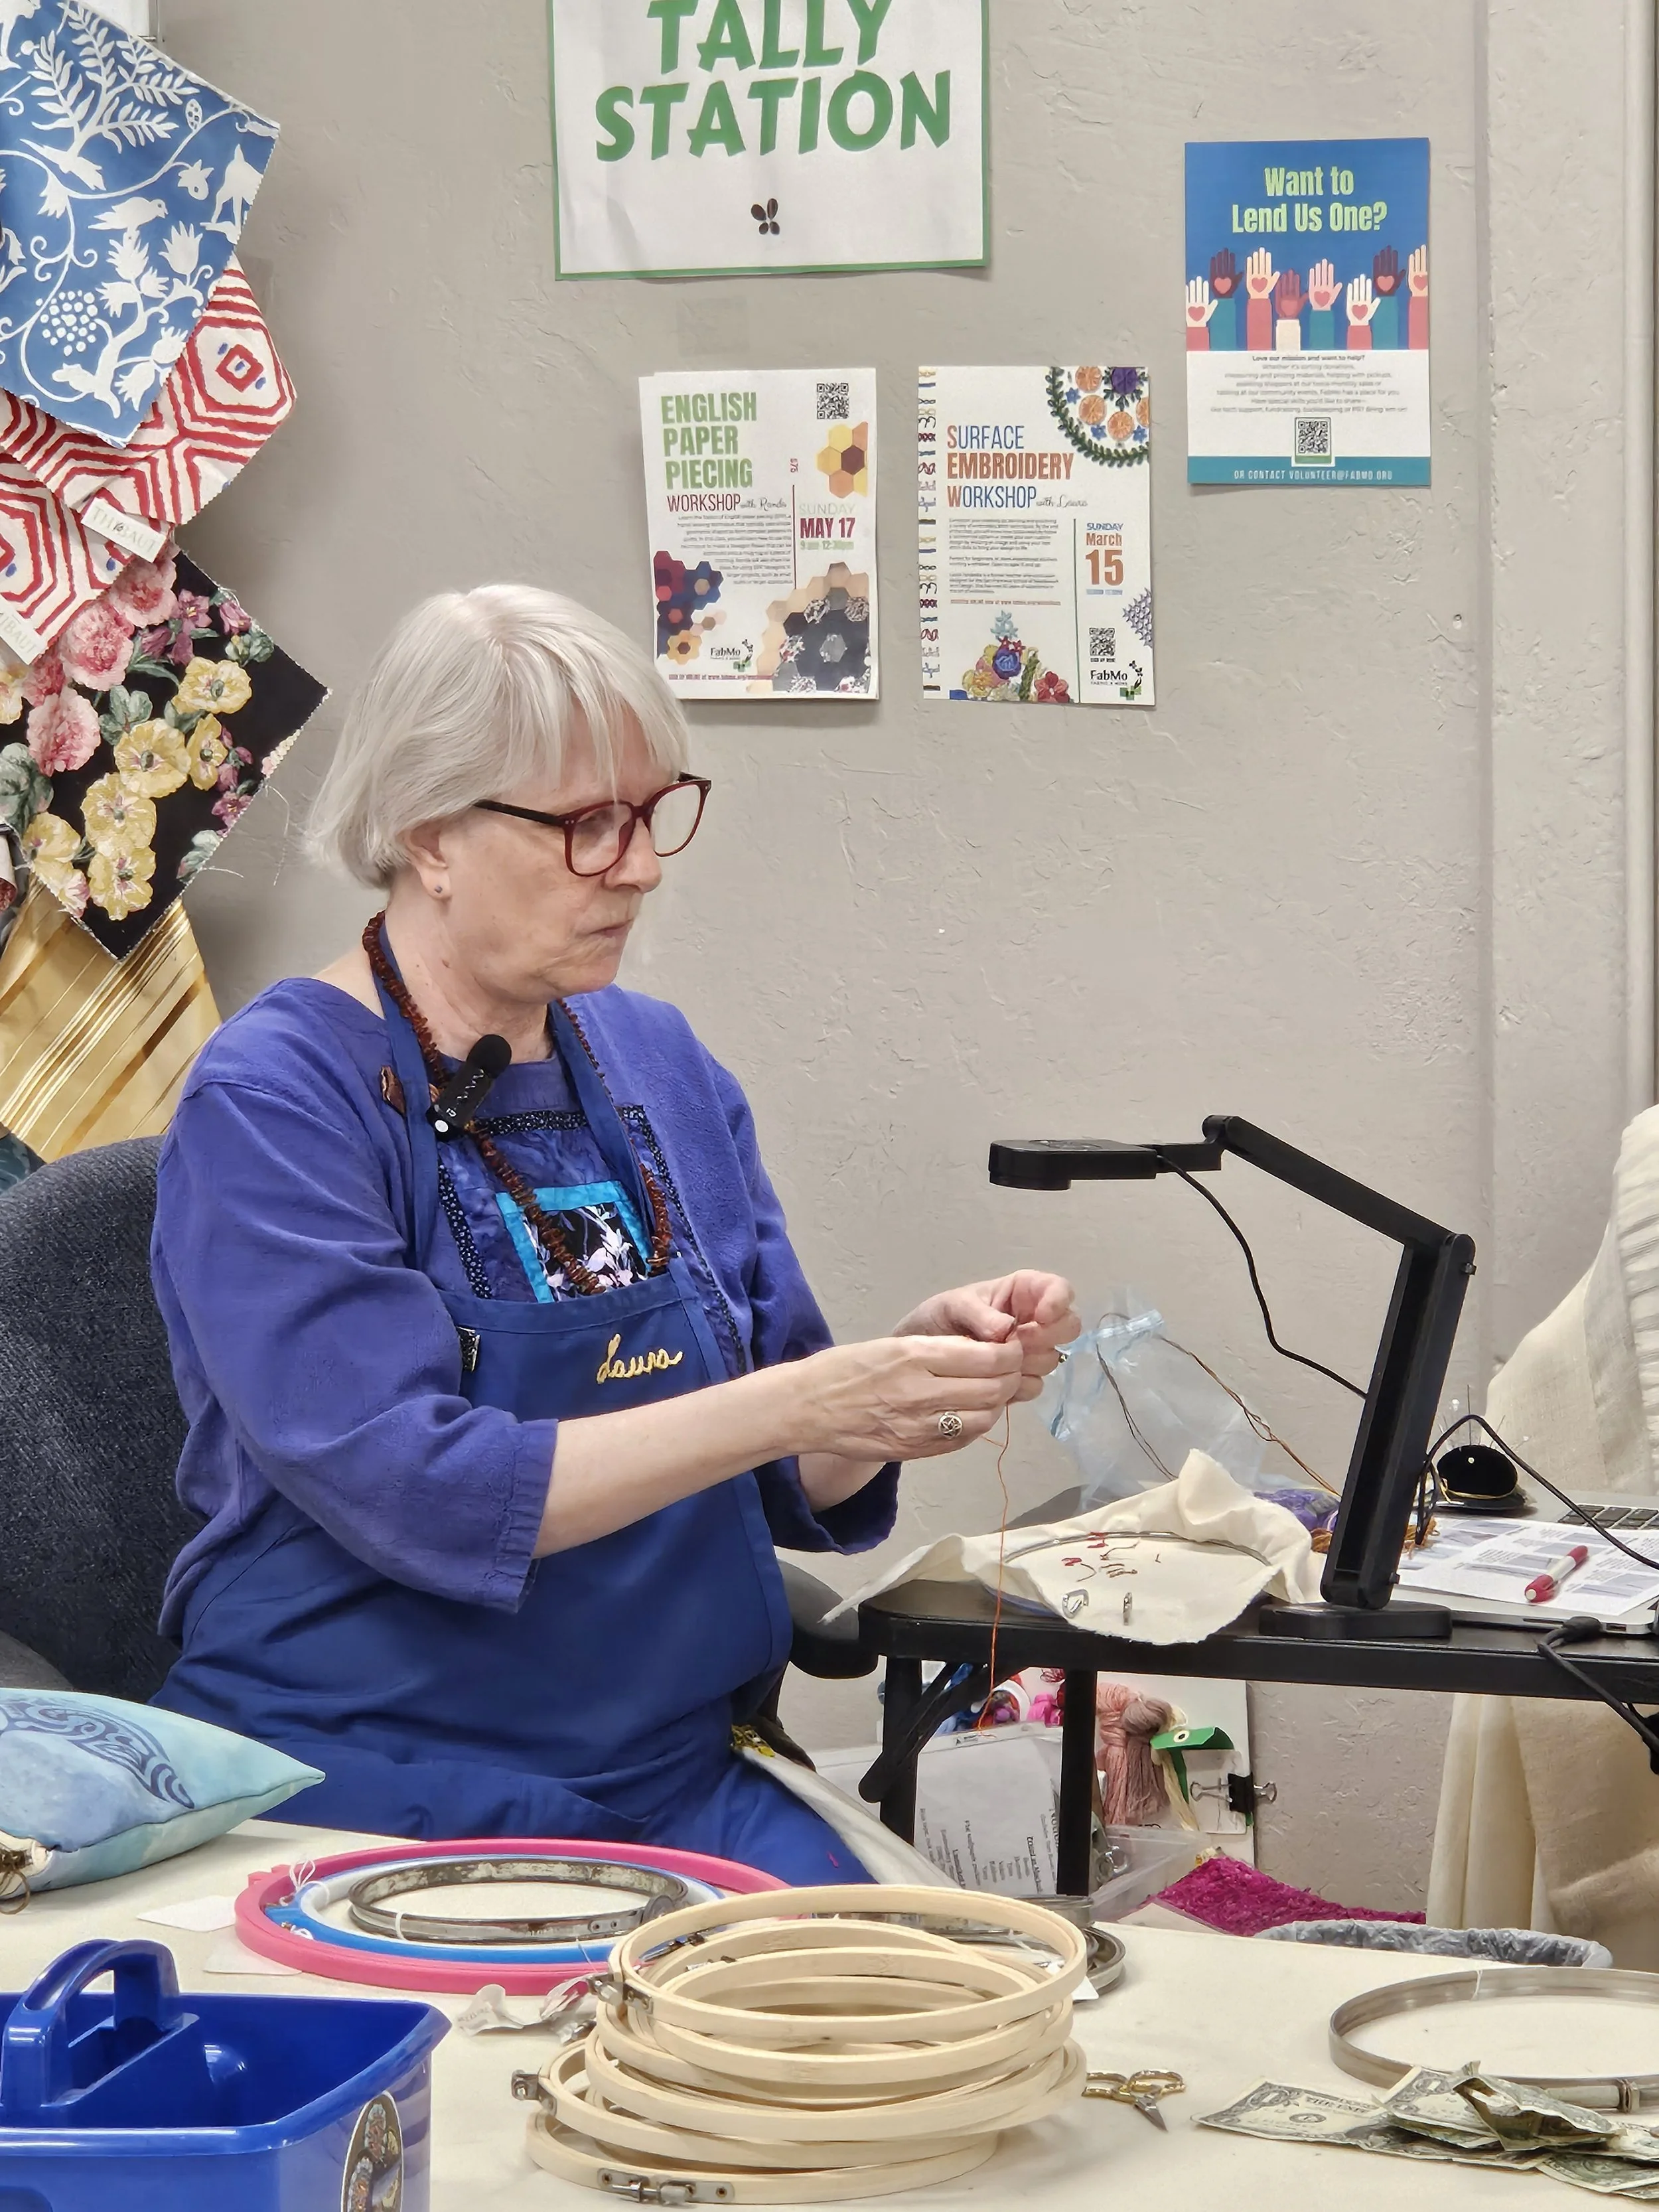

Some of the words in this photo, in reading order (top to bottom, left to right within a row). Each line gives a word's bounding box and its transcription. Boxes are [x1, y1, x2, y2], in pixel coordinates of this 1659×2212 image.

[646, 0, 893, 74] TALLY
[595, 70, 950, 161] STATION
[1264, 167, 1324, 196] Want
[1331, 166, 1354, 196] to
[1232, 203, 1287, 233] Lend
[1295, 203, 1323, 232] Us
[1329, 201, 1388, 232] One?
[661, 392, 757, 424] ENGLISH
[664, 425, 739, 457] PAPER
[948, 425, 1025, 449] SURFACE
[666, 458, 753, 489] PIECING
[948, 453, 1074, 479] EMBROIDERY
[1248, 470, 1285, 479] CONTACT
[667, 494, 741, 512] WORKSHOP
[799, 503, 856, 514] SUNDAY
[948, 486, 1037, 508] WORKSHOP
[800, 518, 833, 538] MAY
[839, 518, 855, 538] 17
[1086, 533, 1121, 546] March
[1086, 550, 1123, 585] 15
[1090, 670, 1127, 680] FabMo
[596, 1333, 684, 1384] Laura
